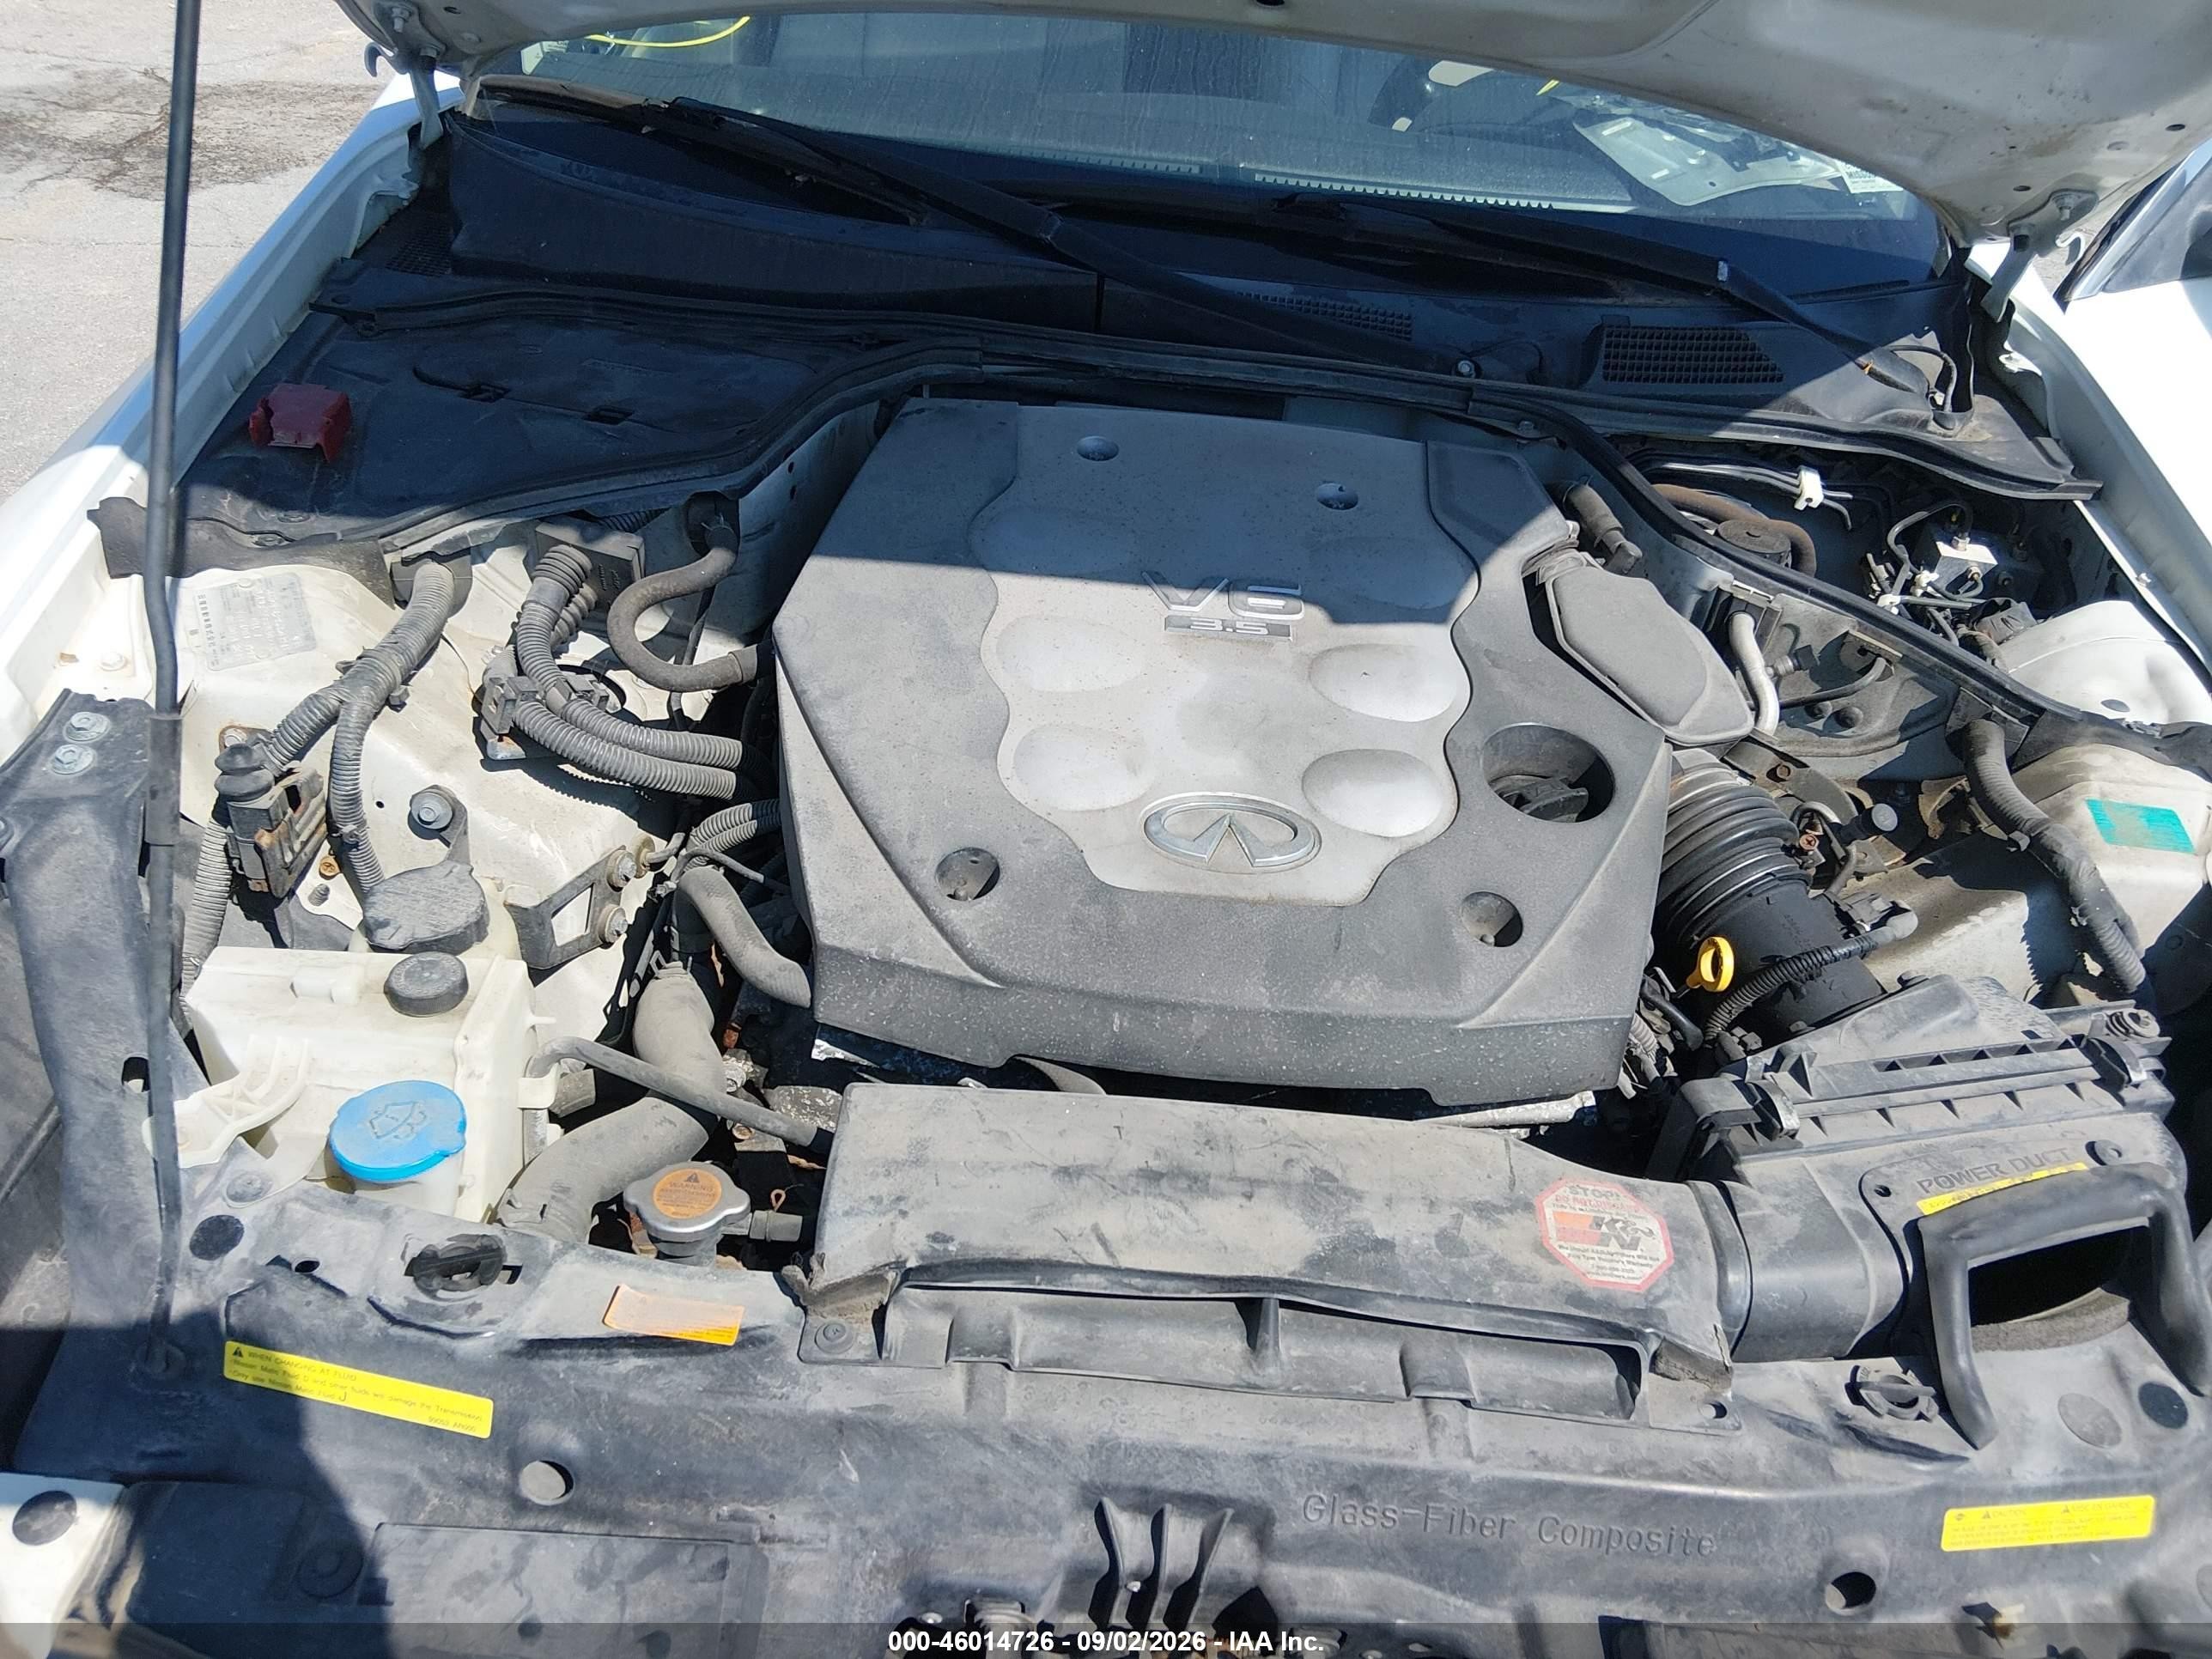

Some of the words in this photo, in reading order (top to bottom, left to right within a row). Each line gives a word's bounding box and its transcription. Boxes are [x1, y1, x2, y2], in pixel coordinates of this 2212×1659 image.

[1140, 571, 1305, 621] V6
[1188, 617, 1270, 636] 3.5
[1917, 1163, 2008, 1194] POWER
[2008, 1147, 2071, 1173] DUCT
[338, 1391, 347, 1402] J
[1302, 1493, 1517, 1540] Glass-Fiber
[1538, 1515, 1720, 1557] Composite
